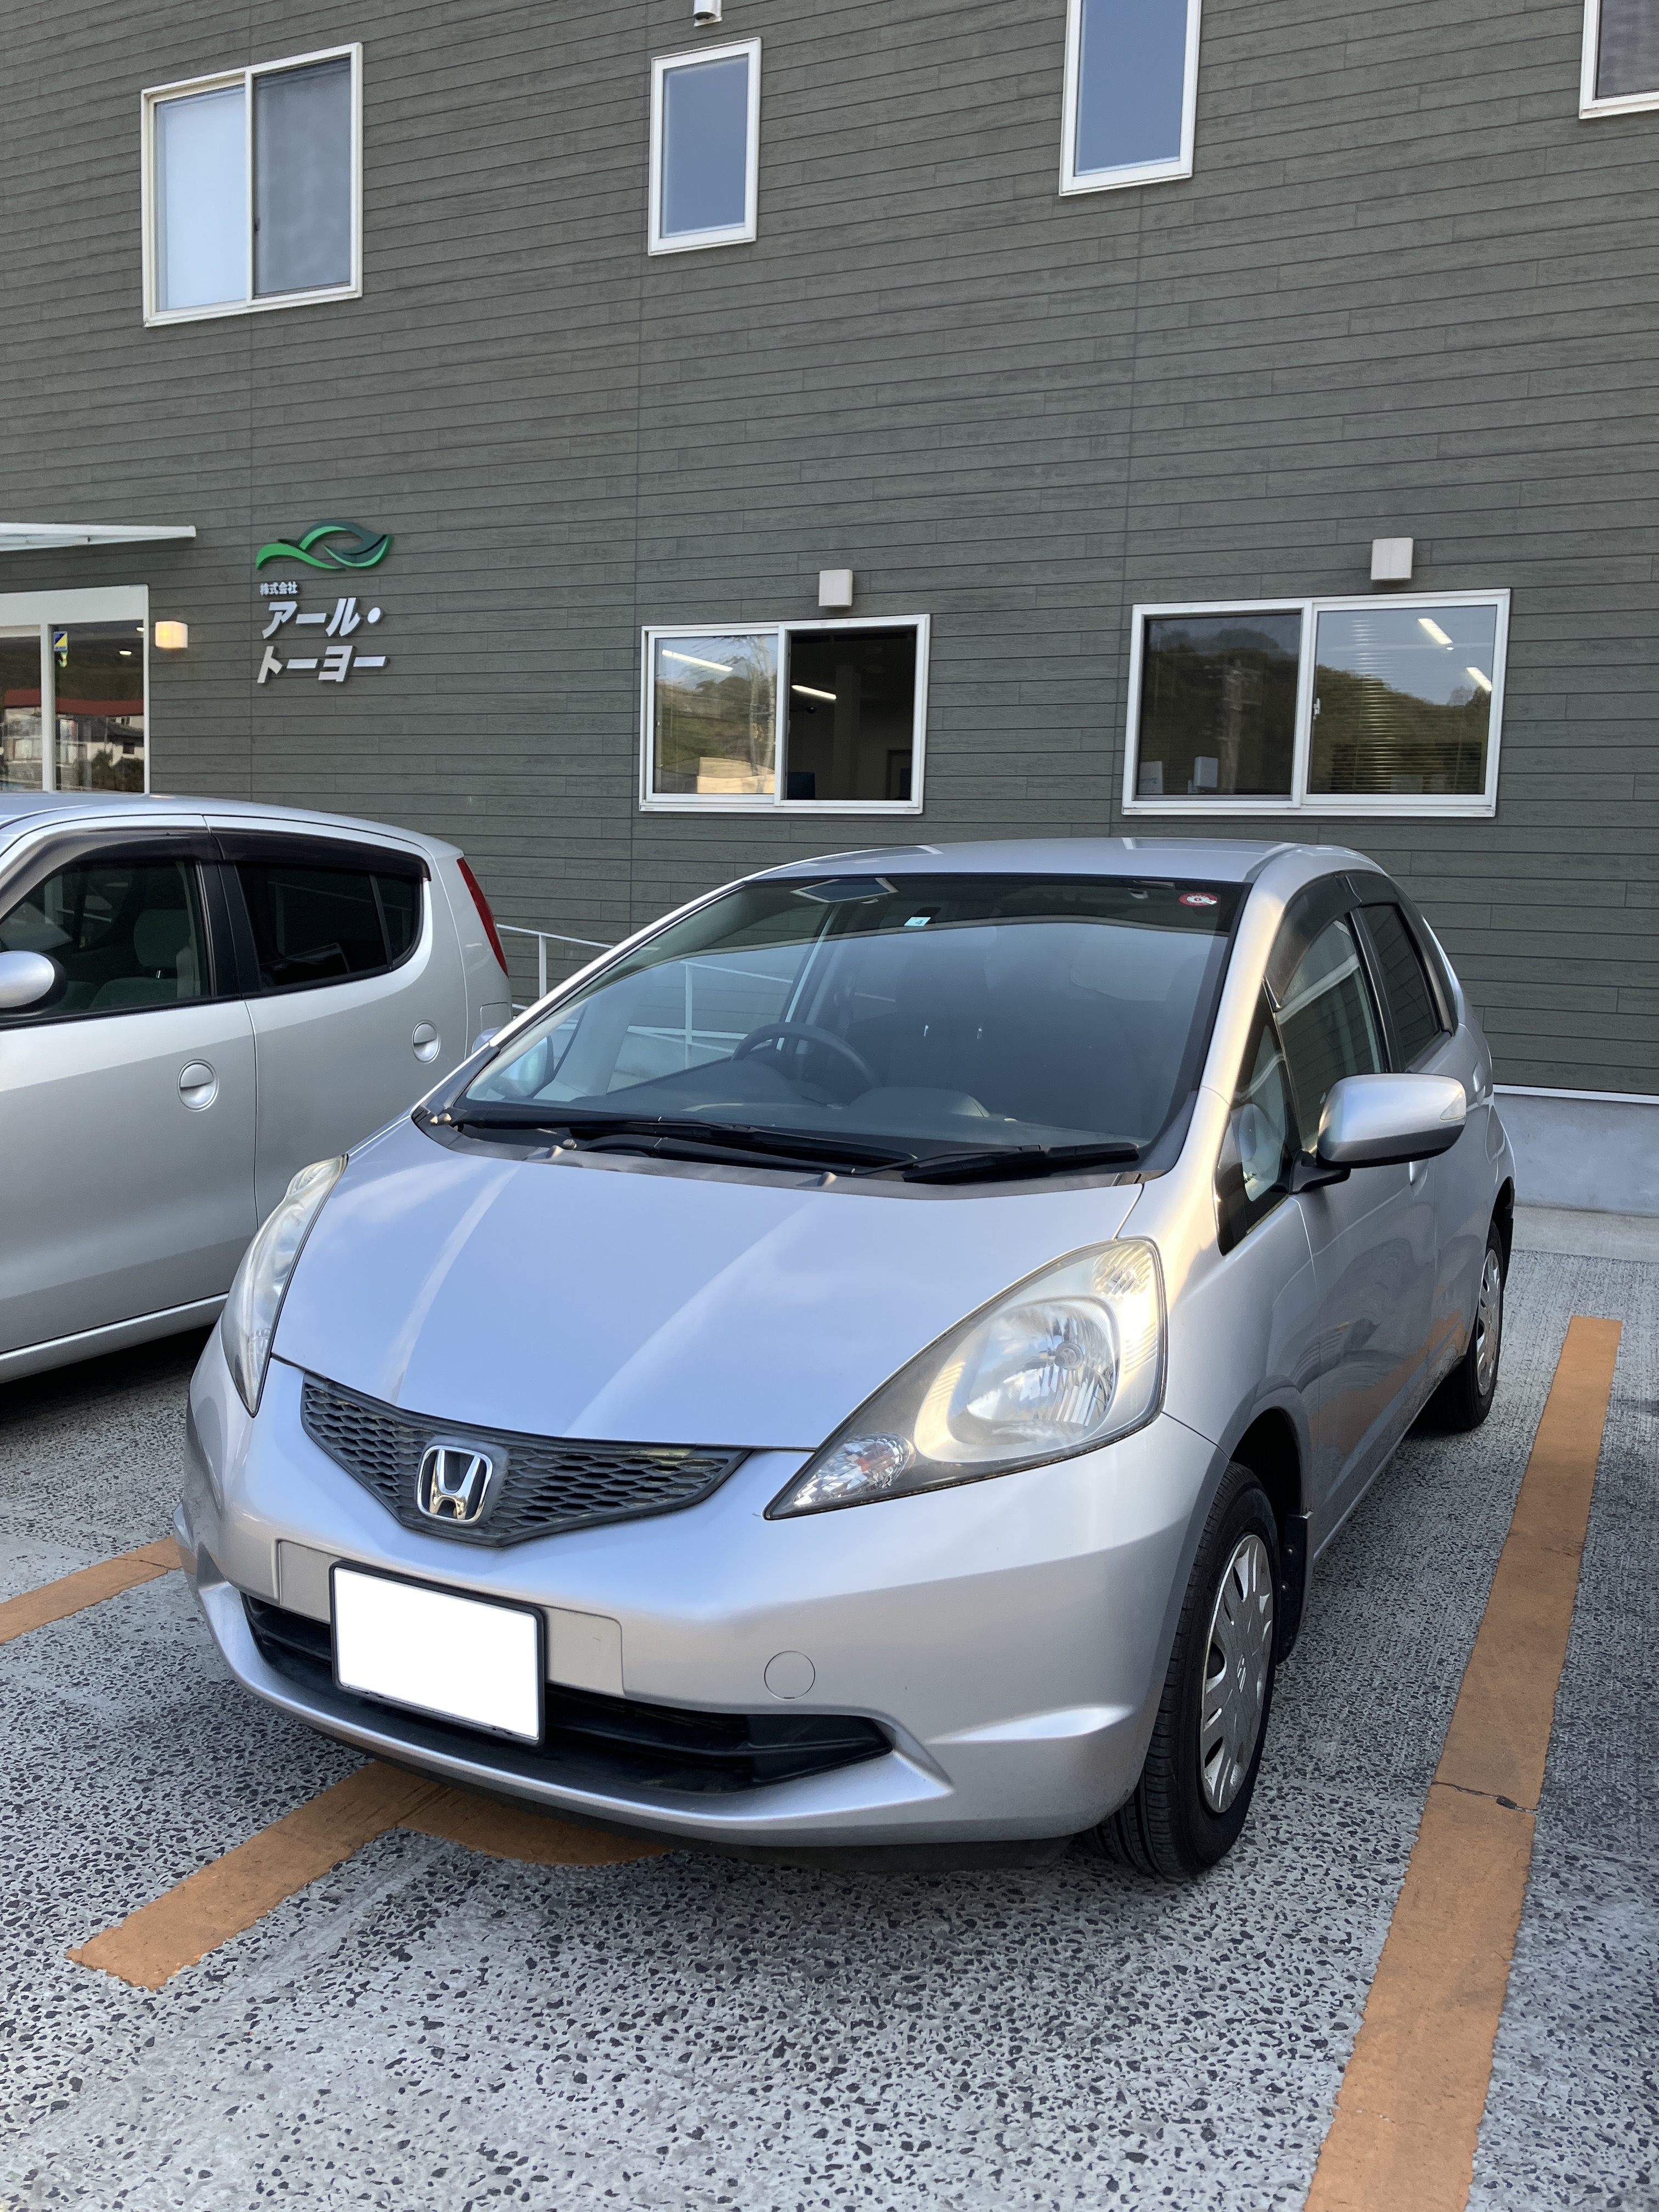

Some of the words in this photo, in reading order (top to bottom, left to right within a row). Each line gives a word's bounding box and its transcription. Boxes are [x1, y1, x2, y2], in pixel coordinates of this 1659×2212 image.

[260, 581, 297, 596] 株式会社
[257, 645, 386, 684] トーヨー
